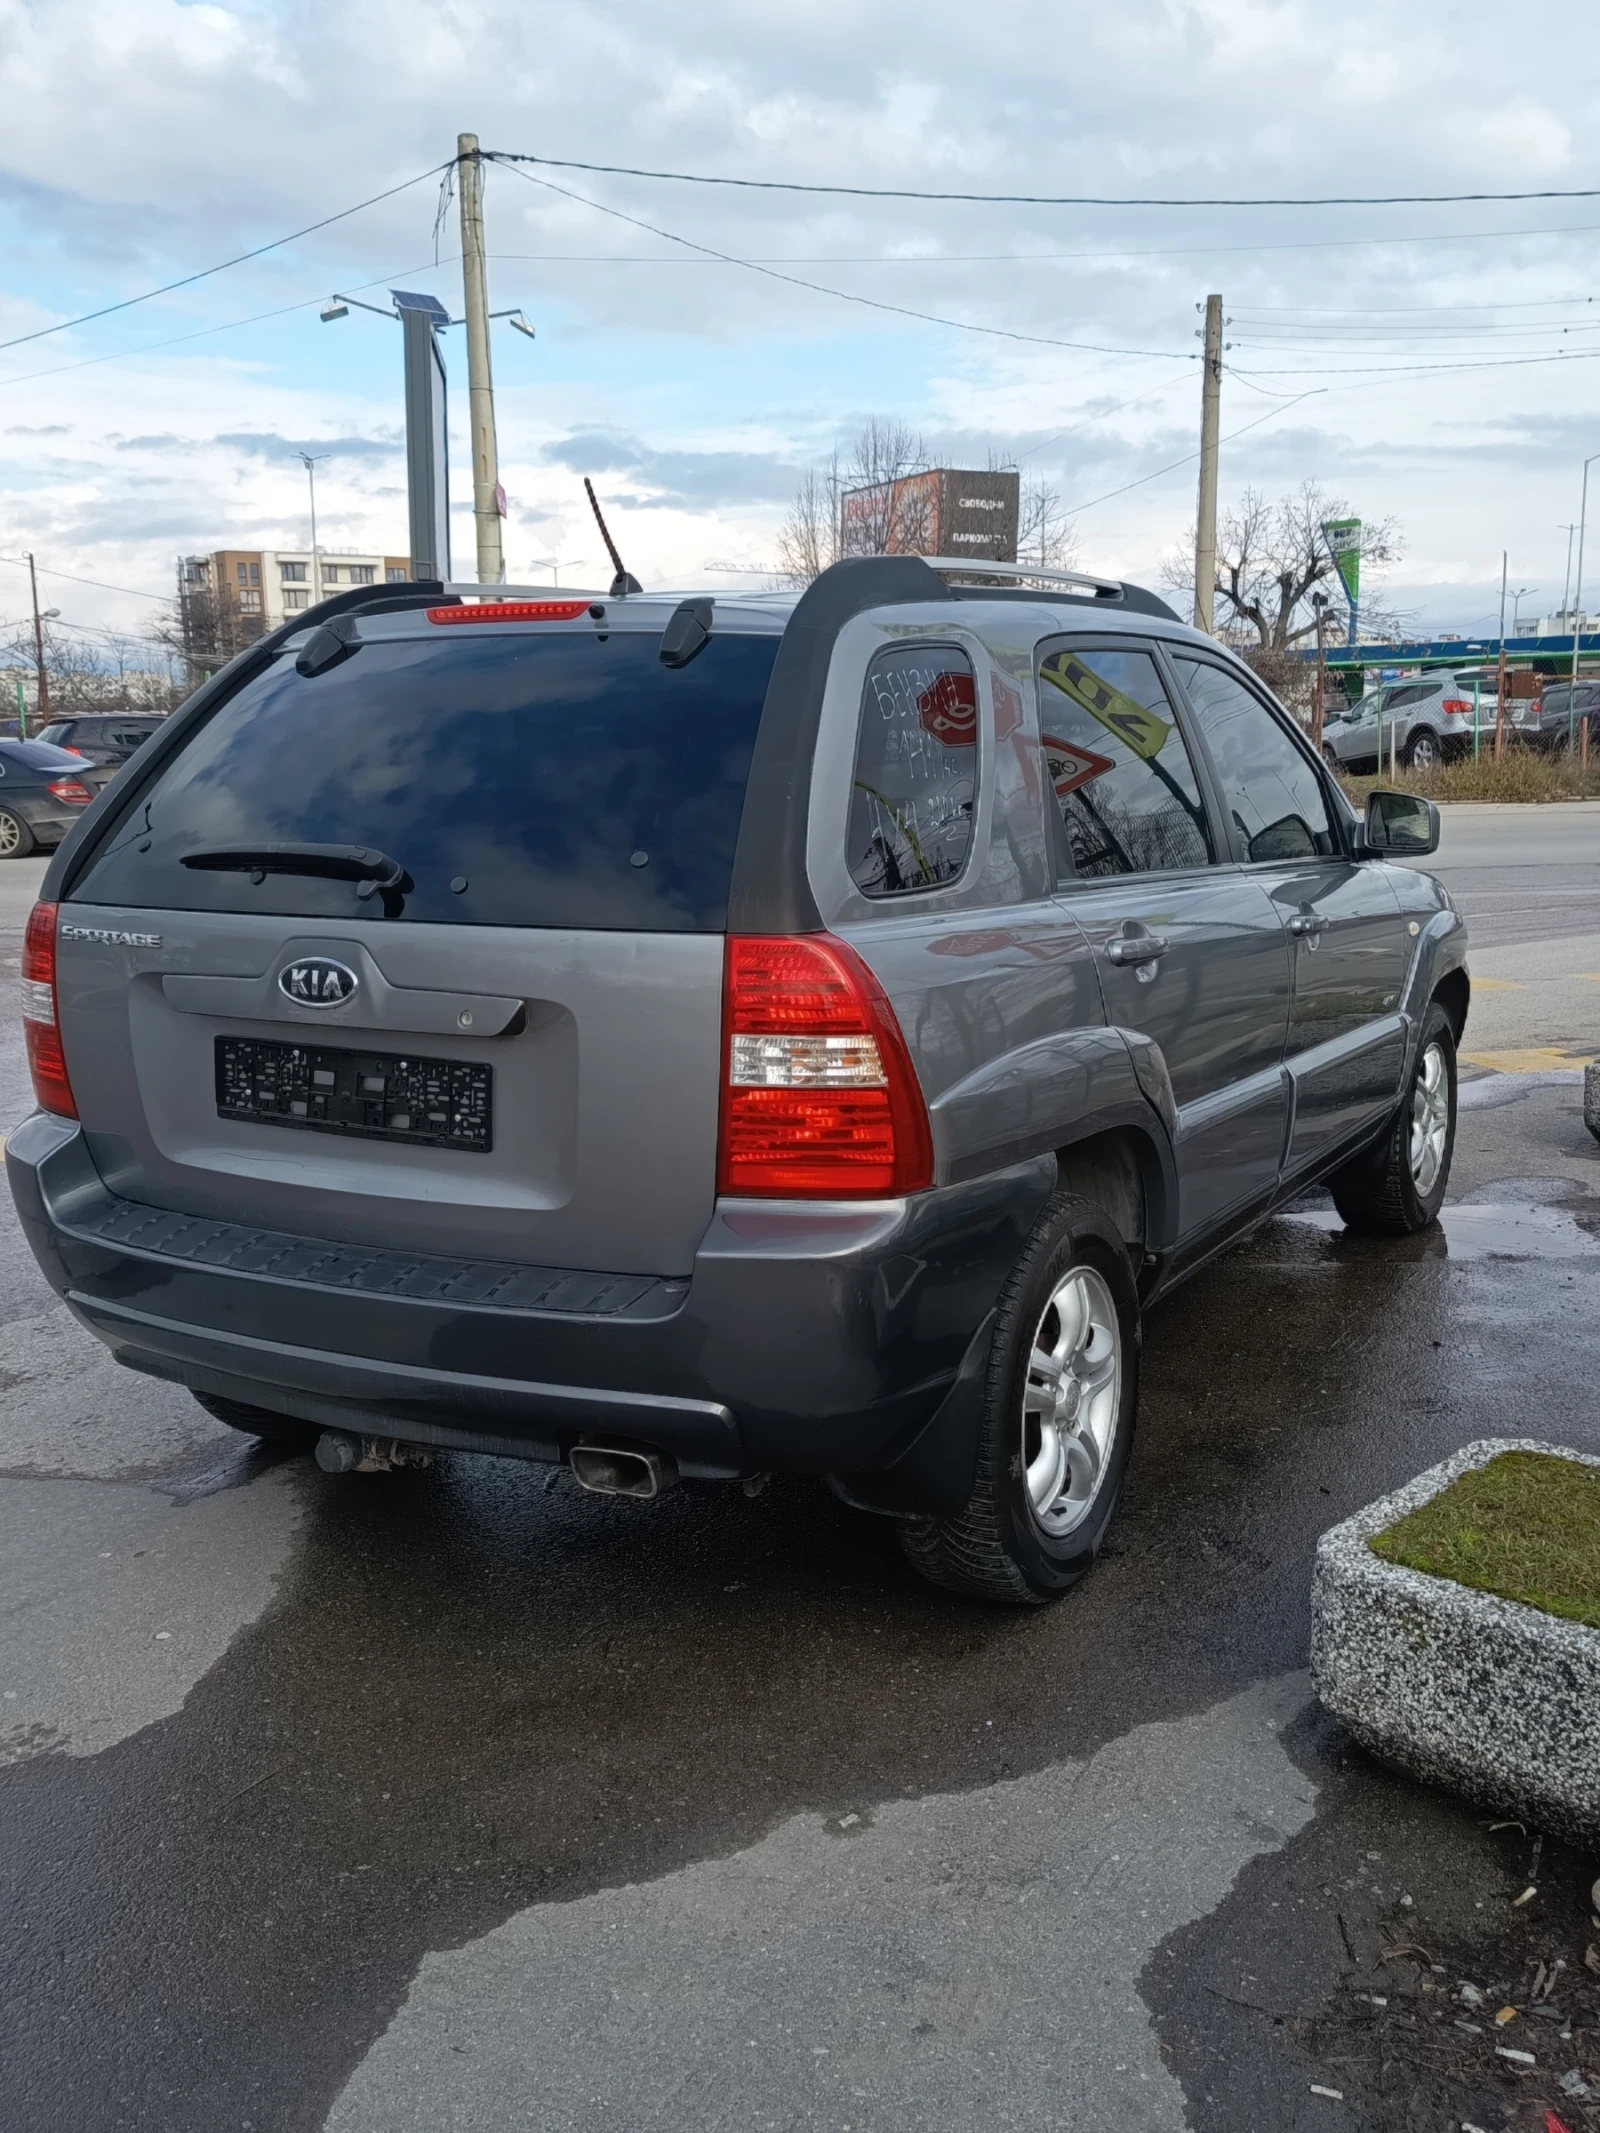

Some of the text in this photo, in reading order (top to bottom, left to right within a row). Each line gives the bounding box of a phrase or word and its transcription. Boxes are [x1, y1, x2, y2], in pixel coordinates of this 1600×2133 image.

[871, 668, 959, 720] БЕНЗИН
[61, 925, 162, 949] SPORTAGE
[291, 968, 343, 998] KIA
